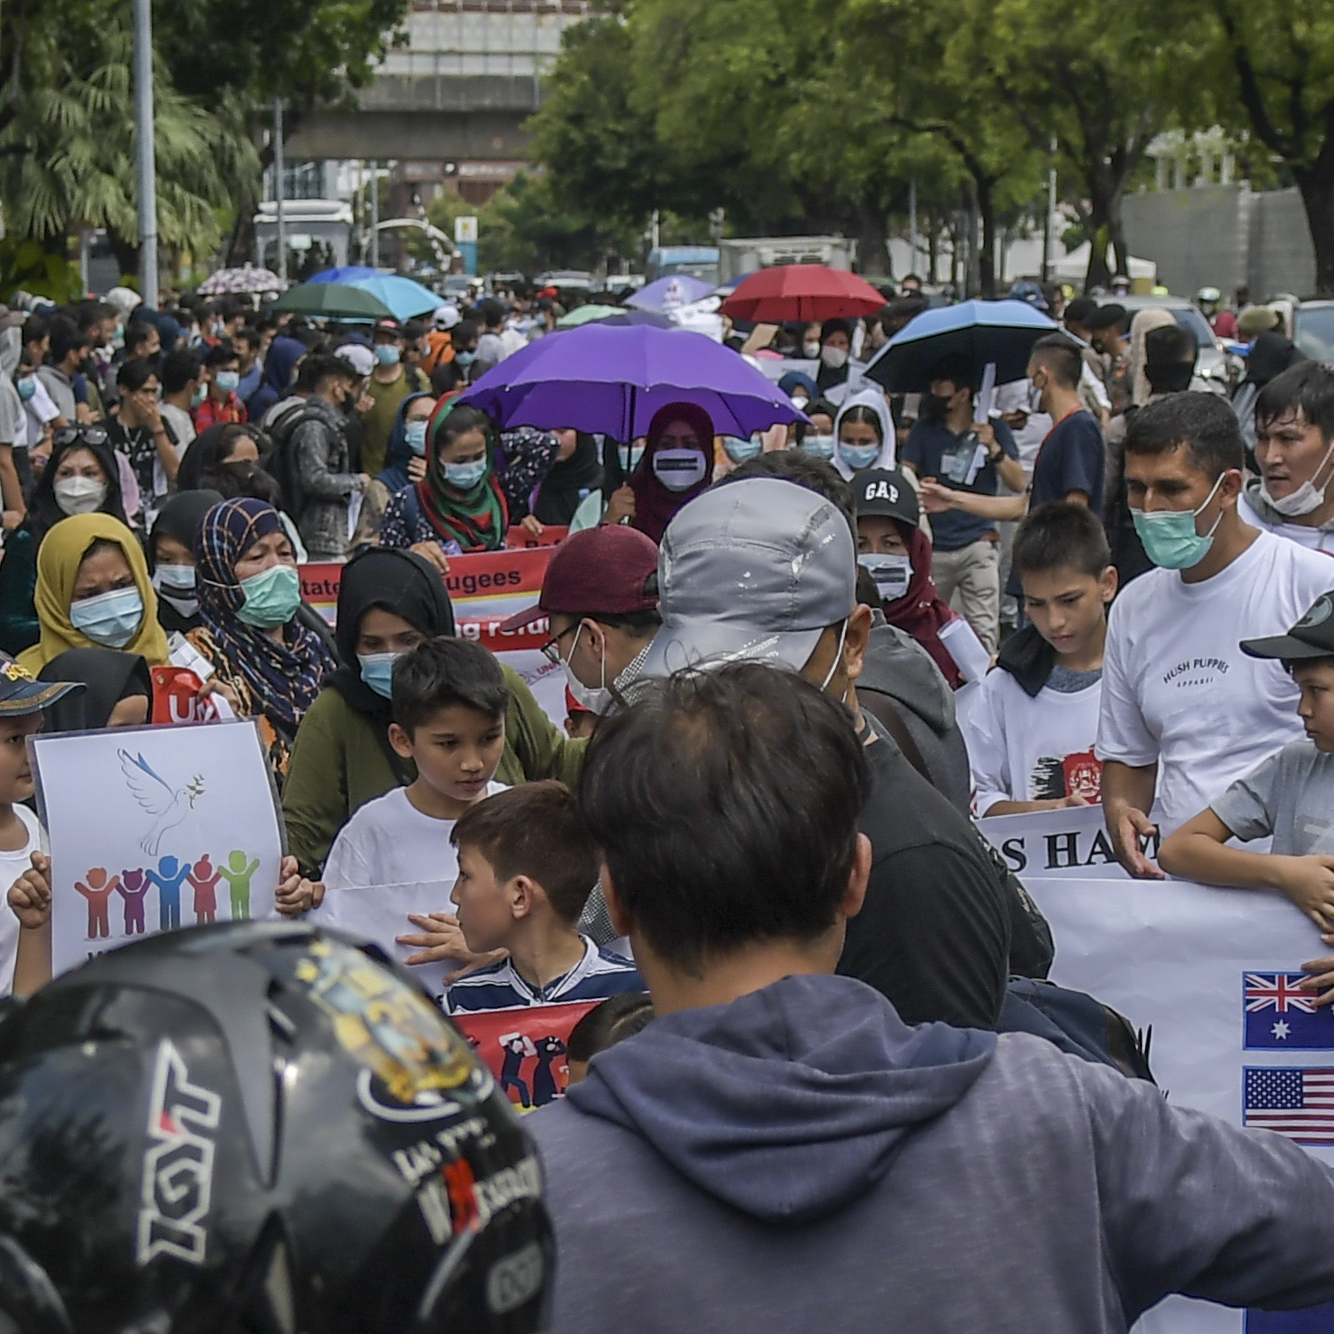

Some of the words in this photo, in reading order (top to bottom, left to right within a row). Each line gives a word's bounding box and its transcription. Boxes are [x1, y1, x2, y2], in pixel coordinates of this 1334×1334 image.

[865, 481, 899, 503] GAP
[1163, 661, 1190, 684] HUSH
[1193, 658, 1229, 674] PUPPIES
